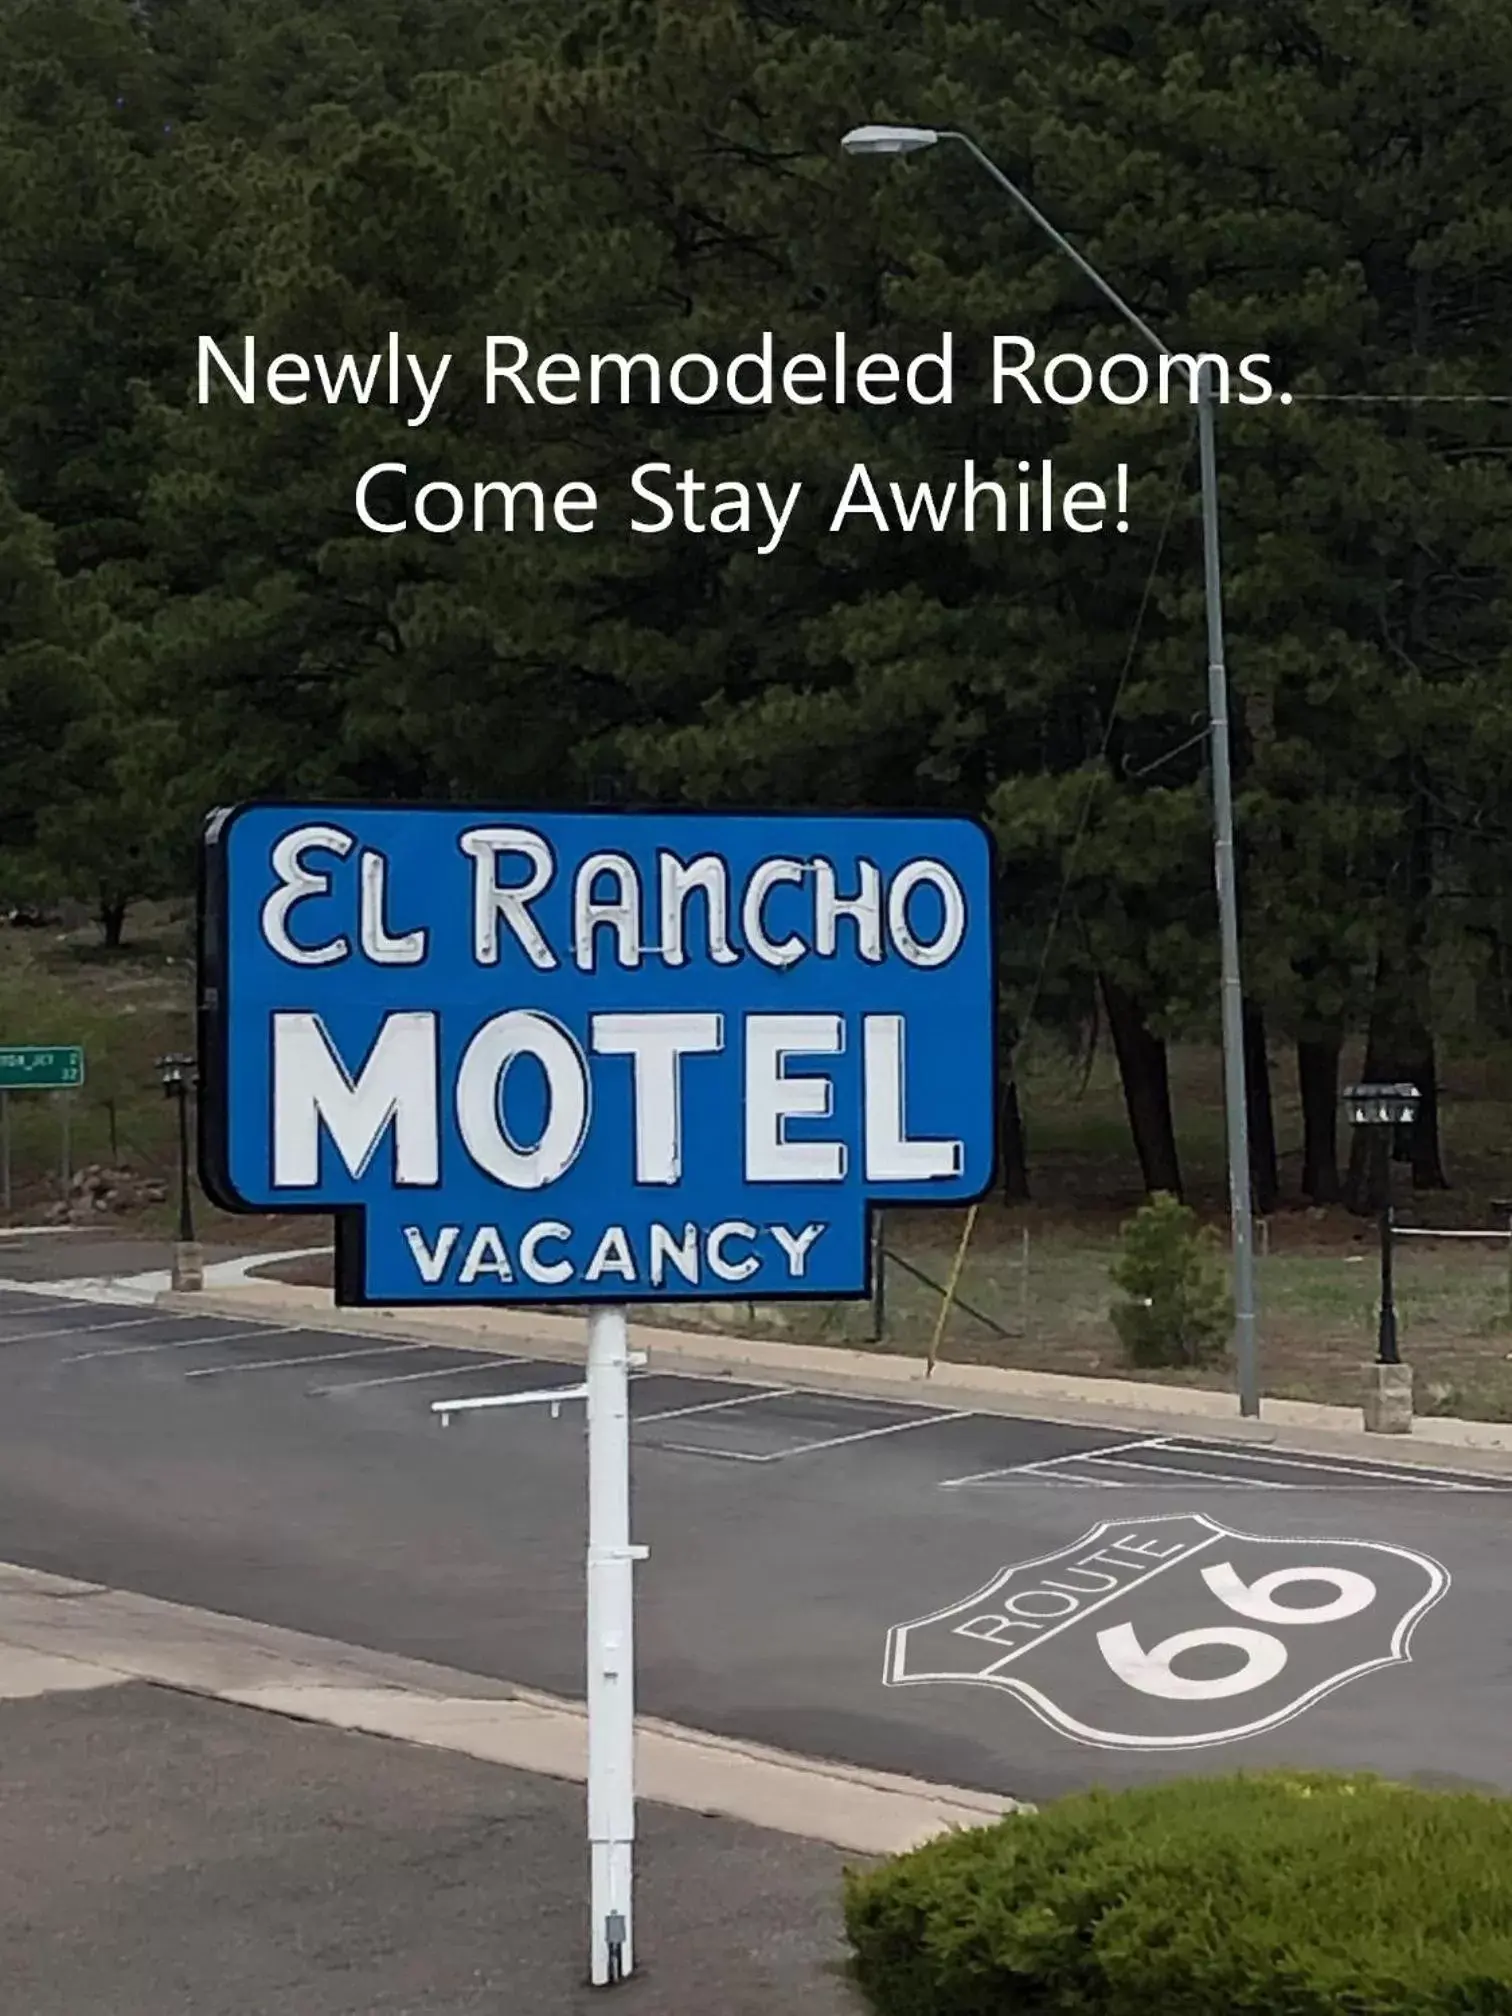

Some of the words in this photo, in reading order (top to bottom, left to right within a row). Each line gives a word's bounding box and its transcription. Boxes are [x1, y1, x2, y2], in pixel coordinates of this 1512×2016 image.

[262, 825, 426, 966] EL
[273, 1010, 964, 1188] MOTEL
[404, 1221, 827, 1286] VACANCY
[952, 1533, 1185, 1646] ROUTE
[1096, 1561, 1377, 1700] 66
